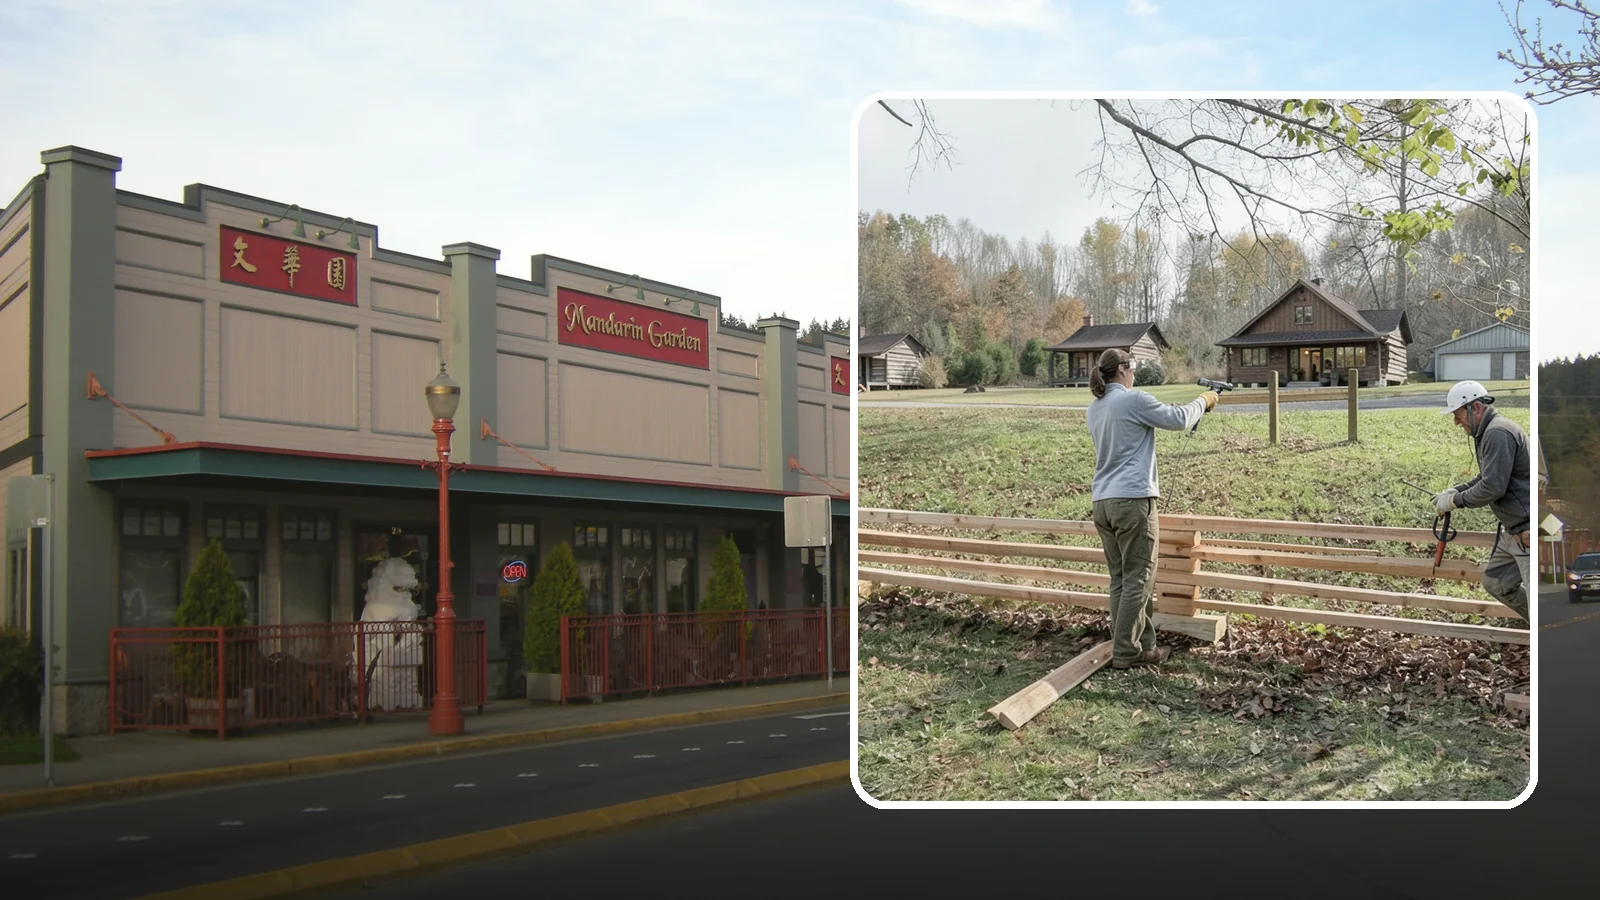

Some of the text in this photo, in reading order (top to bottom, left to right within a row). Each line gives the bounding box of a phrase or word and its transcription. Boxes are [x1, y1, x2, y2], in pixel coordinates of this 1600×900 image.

[231, 235, 346, 291] 文華園
[564, 302, 701, 352] Mandarin Garden
[503, 565, 527, 578] OPEN
